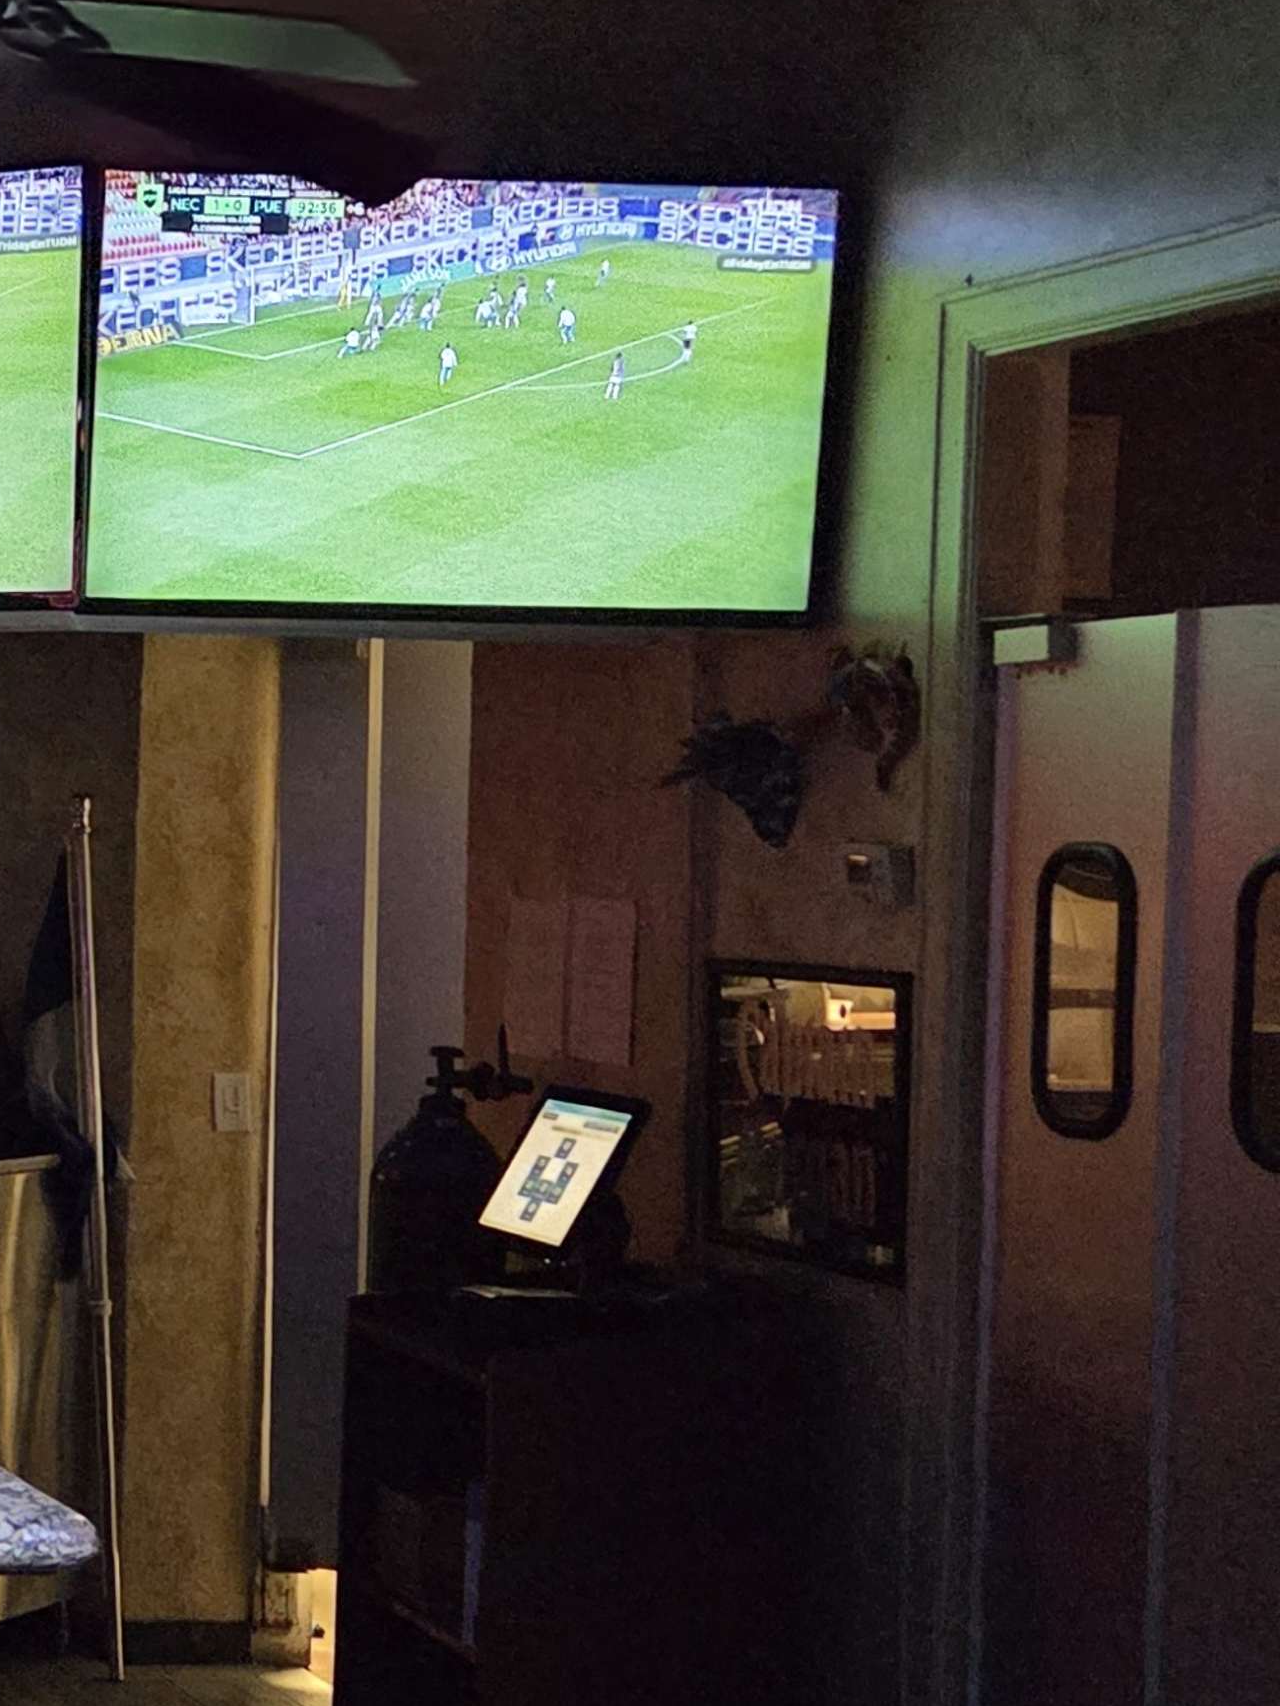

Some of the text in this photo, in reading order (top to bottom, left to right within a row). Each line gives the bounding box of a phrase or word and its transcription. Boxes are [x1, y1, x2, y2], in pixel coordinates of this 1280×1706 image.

[170, 199, 201, 213] NEC
[254, 200, 283, 214] PUE
[298, 201, 336, 215] 92:36
[206, 196, 817, 278] SKECHERS SKECHERS SKECHERS SKECHERS
[658, 222, 815, 257] SKECHERS
